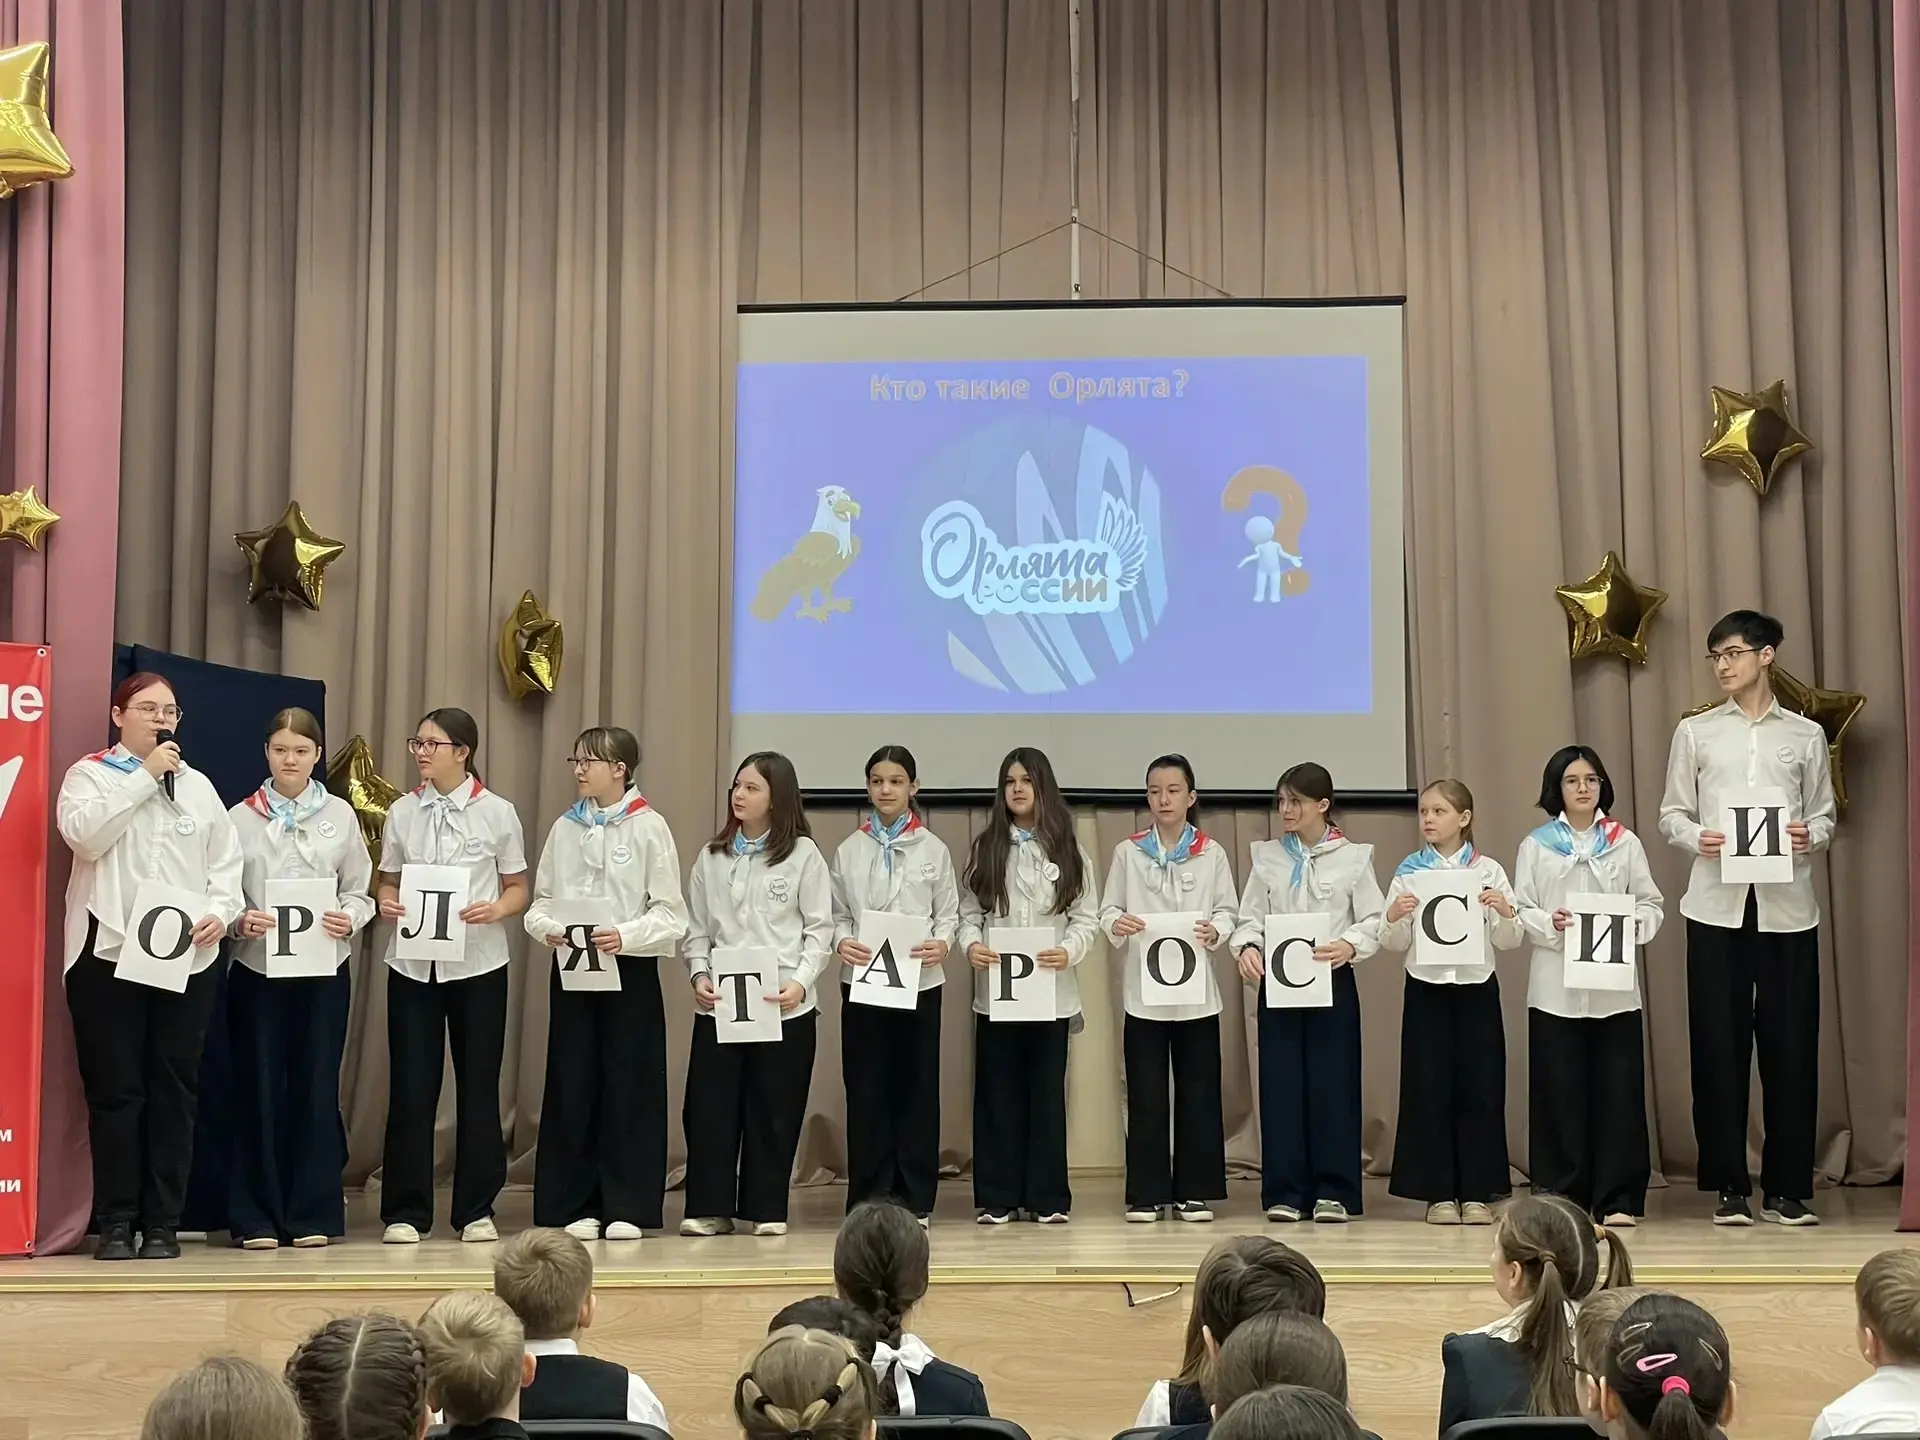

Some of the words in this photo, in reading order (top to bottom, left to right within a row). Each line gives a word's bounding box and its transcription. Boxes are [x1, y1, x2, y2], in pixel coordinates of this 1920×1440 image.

[869, 374, 927, 400] Кто
[935, 379, 1031, 400] такие
[1048, 368, 1190, 404] Орлята?
[929, 511, 1109, 596] Орлята
[0, 683, 44, 722] е
[1727, 806, 1788, 857] И
[137, 905, 195, 961] О
[271, 905, 314, 957] Р
[400, 889, 457, 941] Л
[1421, 894, 1468, 946] С
[1574, 912, 1631, 965] И
[561, 923, 607, 972] Я
[856, 937, 907, 989] А
[1146, 937, 1197, 987] О
[1271, 937, 1316, 989] С
[718, 972, 762, 1023] Т
[994, 951, 1035, 1002] Р
